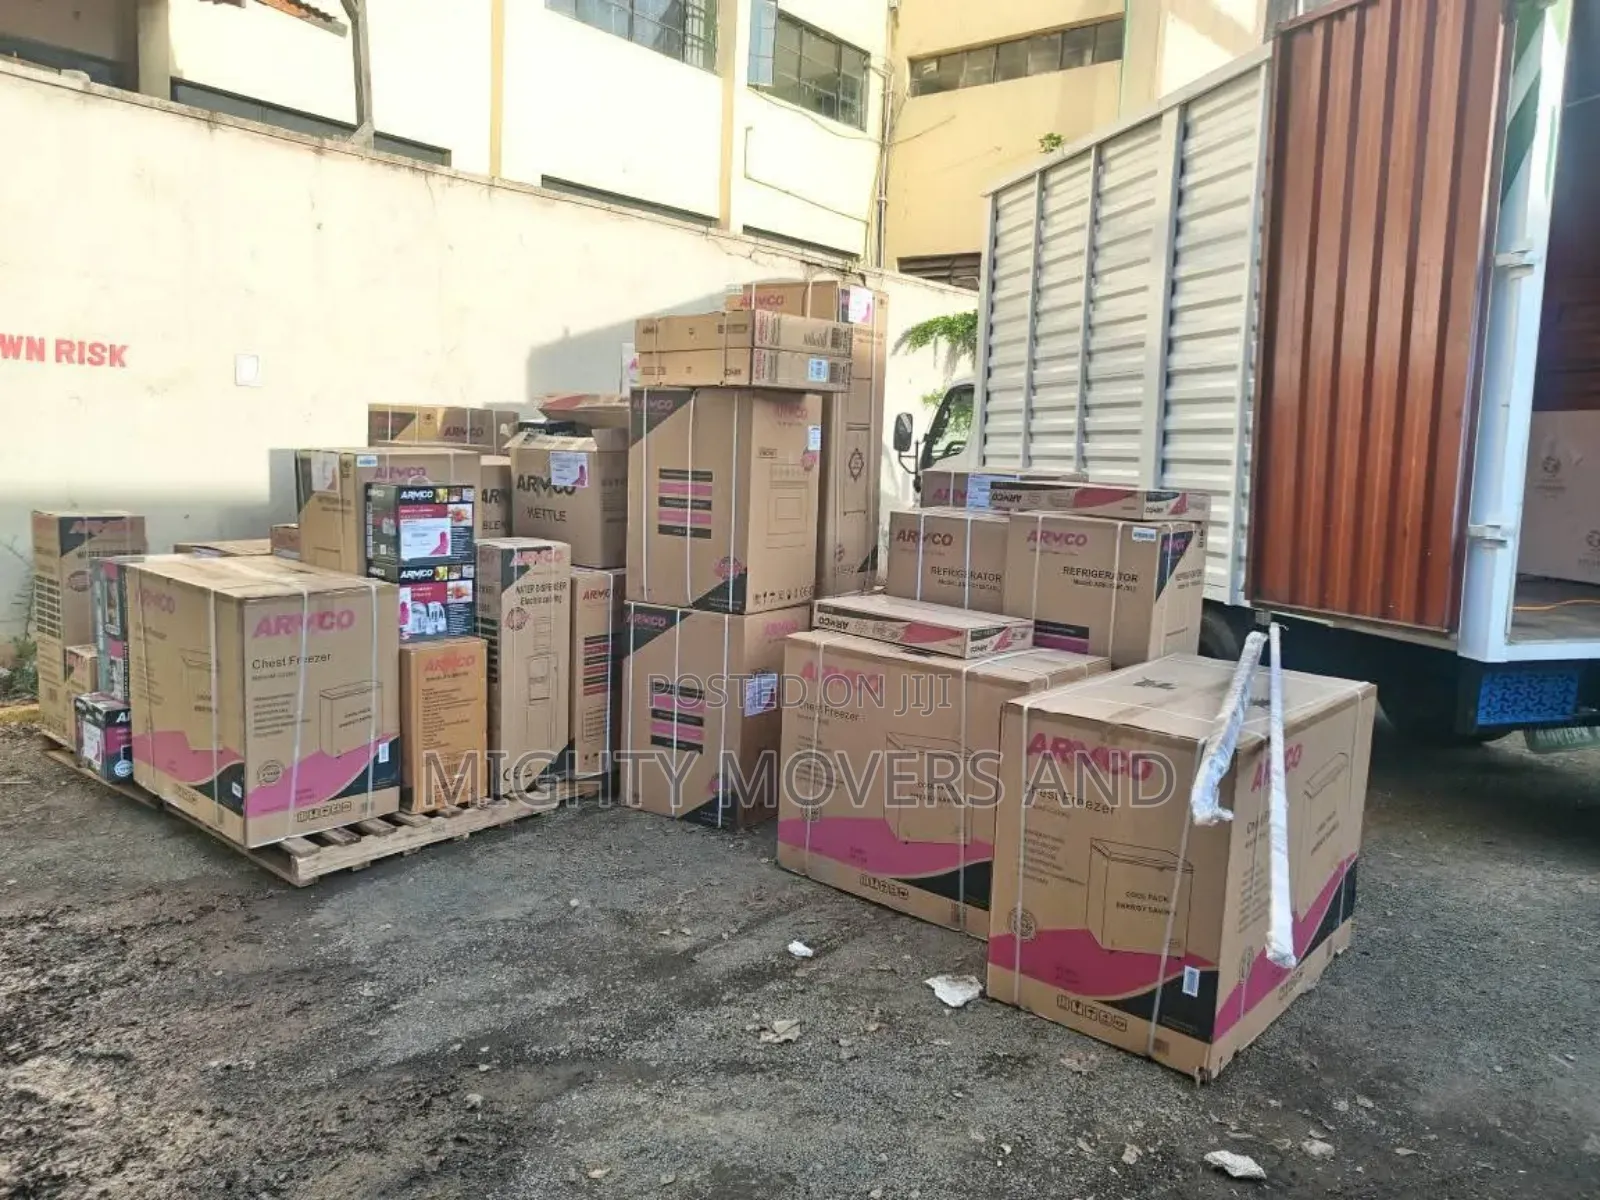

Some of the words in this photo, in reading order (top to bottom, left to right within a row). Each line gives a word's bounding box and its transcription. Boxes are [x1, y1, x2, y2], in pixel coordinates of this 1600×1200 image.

[55, 339, 129, 367] RISK
[401, 490, 433, 500] ARMCO
[896, 529, 953, 546] ARMCO
[1027, 531, 1088, 546] ARMCO
[401, 569, 433, 579] ARMCO
[930, 566, 1002, 582] REFRIGRATOR
[252, 609, 356, 638] ARMCO
[252, 658, 286, 669] Chest
[1028, 733, 1154, 781] ARMCO
